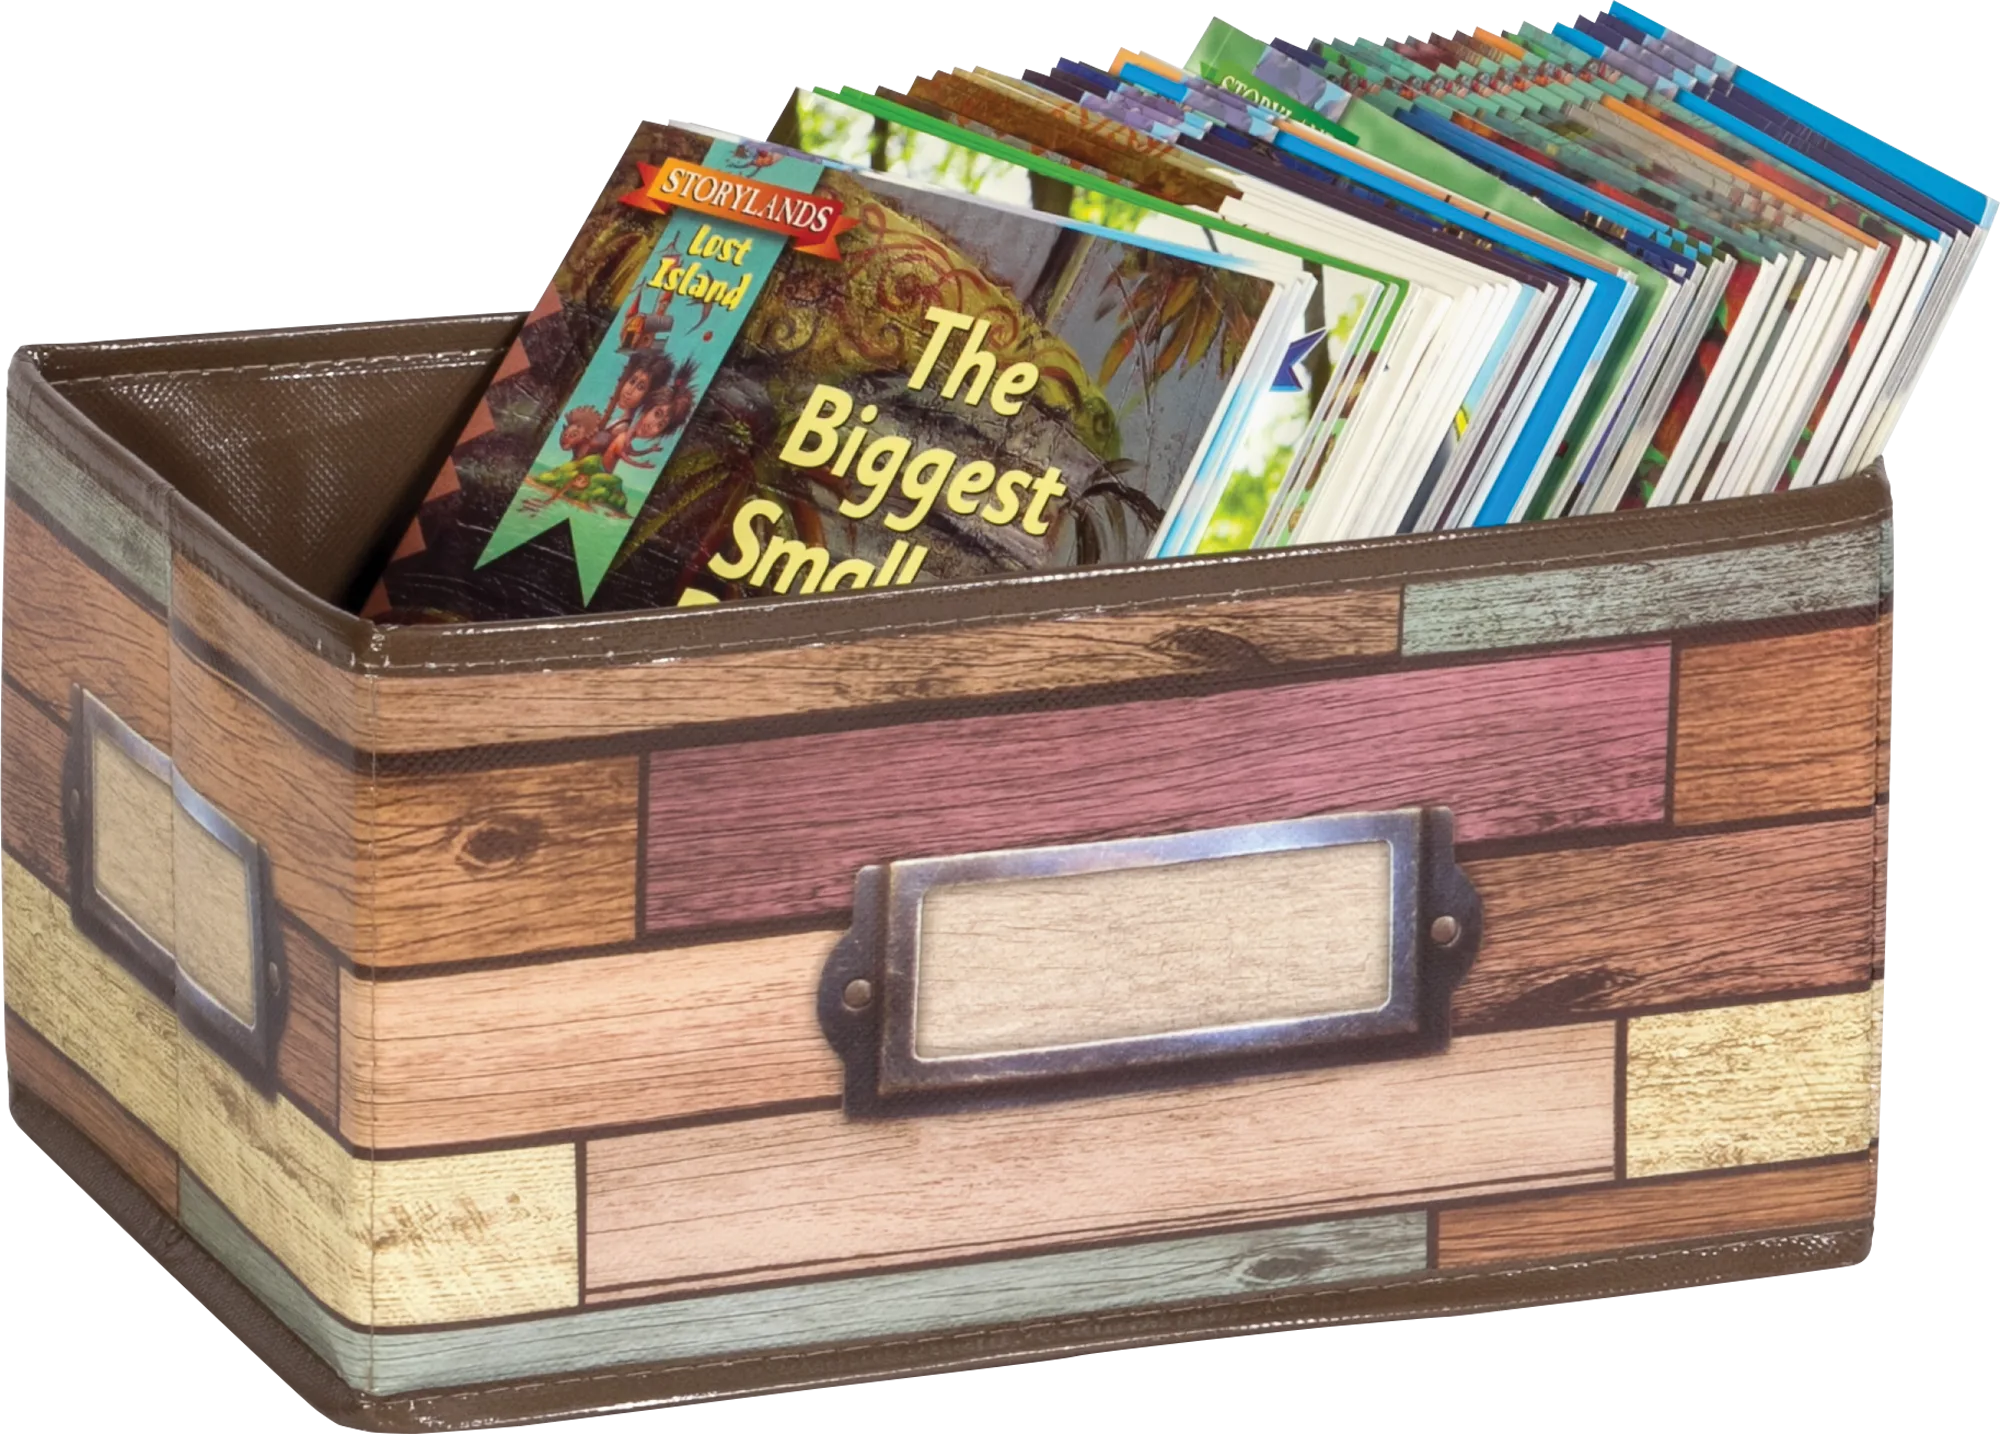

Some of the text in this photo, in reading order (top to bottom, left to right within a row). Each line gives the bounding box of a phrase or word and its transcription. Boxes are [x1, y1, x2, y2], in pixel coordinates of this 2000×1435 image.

[661, 167, 834, 233] STORYLANDS
[688, 224, 753, 267] Lost
[648, 257, 753, 312] Island
[908, 306, 1039, 416] The
[779, 384, 1067, 536] Biggest
